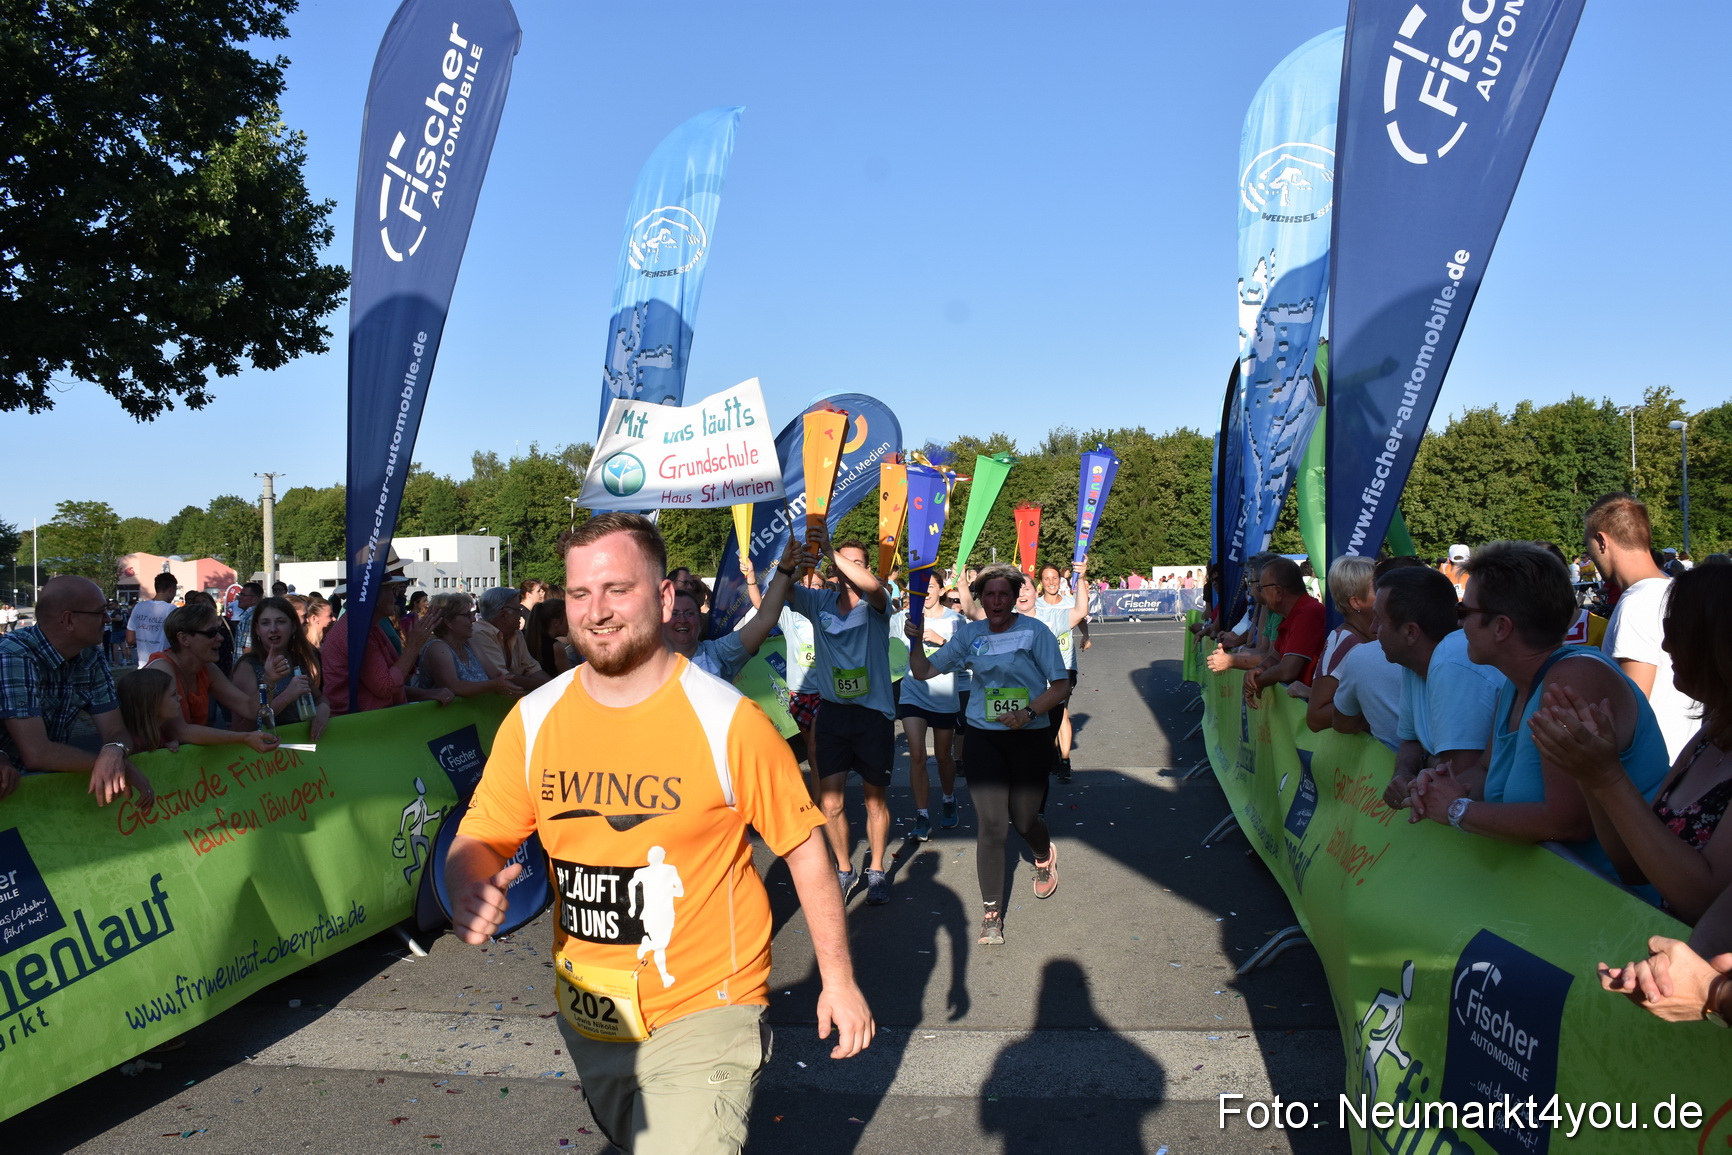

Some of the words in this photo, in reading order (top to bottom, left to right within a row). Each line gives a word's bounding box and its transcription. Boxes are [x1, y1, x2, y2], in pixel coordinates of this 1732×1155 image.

[398, 22, 468, 223] Fischer
[431, 43, 483, 209] AUTOMOBILE
[615, 409, 648, 439] Mit
[663, 424, 695, 444] uns
[702, 396, 755, 436] läufts
[358, 331, 427, 603] www.fischer-automobile.de
[658, 440, 759, 479] Grundschule
[838, 471, 857, 491] und
[855, 441, 891, 474] Medien
[661, 489, 692, 503] Haus
[701, 484, 720, 502] St.
[722, 478, 775, 499] Marien
[1077, 465, 1104, 547] GRUNDSCHULE
[1124, 600, 1162, 608] Fischer
[838, 678, 859, 690] 651
[993, 700, 1019, 712] 645
[447, 748, 477, 766] Fischer
[117, 767, 228, 836] Gesunde
[226, 748, 305, 788] Firmen
[182, 807, 263, 856] laufen
[258, 765, 335, 821] länger!
[541, 769, 555, 802] BIT
[558, 770, 682, 811] WINGS
[4, 922, 26, 944] fährt
[28, 908, 49, 926] mit!
[11, 898, 47, 921] Lächeln
[562, 901, 578, 934] BEI
[580, 908, 620, 939] UNS
[124, 900, 368, 1031] www.firmenlauf-oberpfalz.de
[568, 985, 619, 1024] 202
[574, 1014, 592, 1027] Lewis
[592, 1019, 619, 1032] Nikolai
[1466, 988, 1540, 1061] Fischer
[1469, 1030, 1530, 1082] AUTOMOBILE
